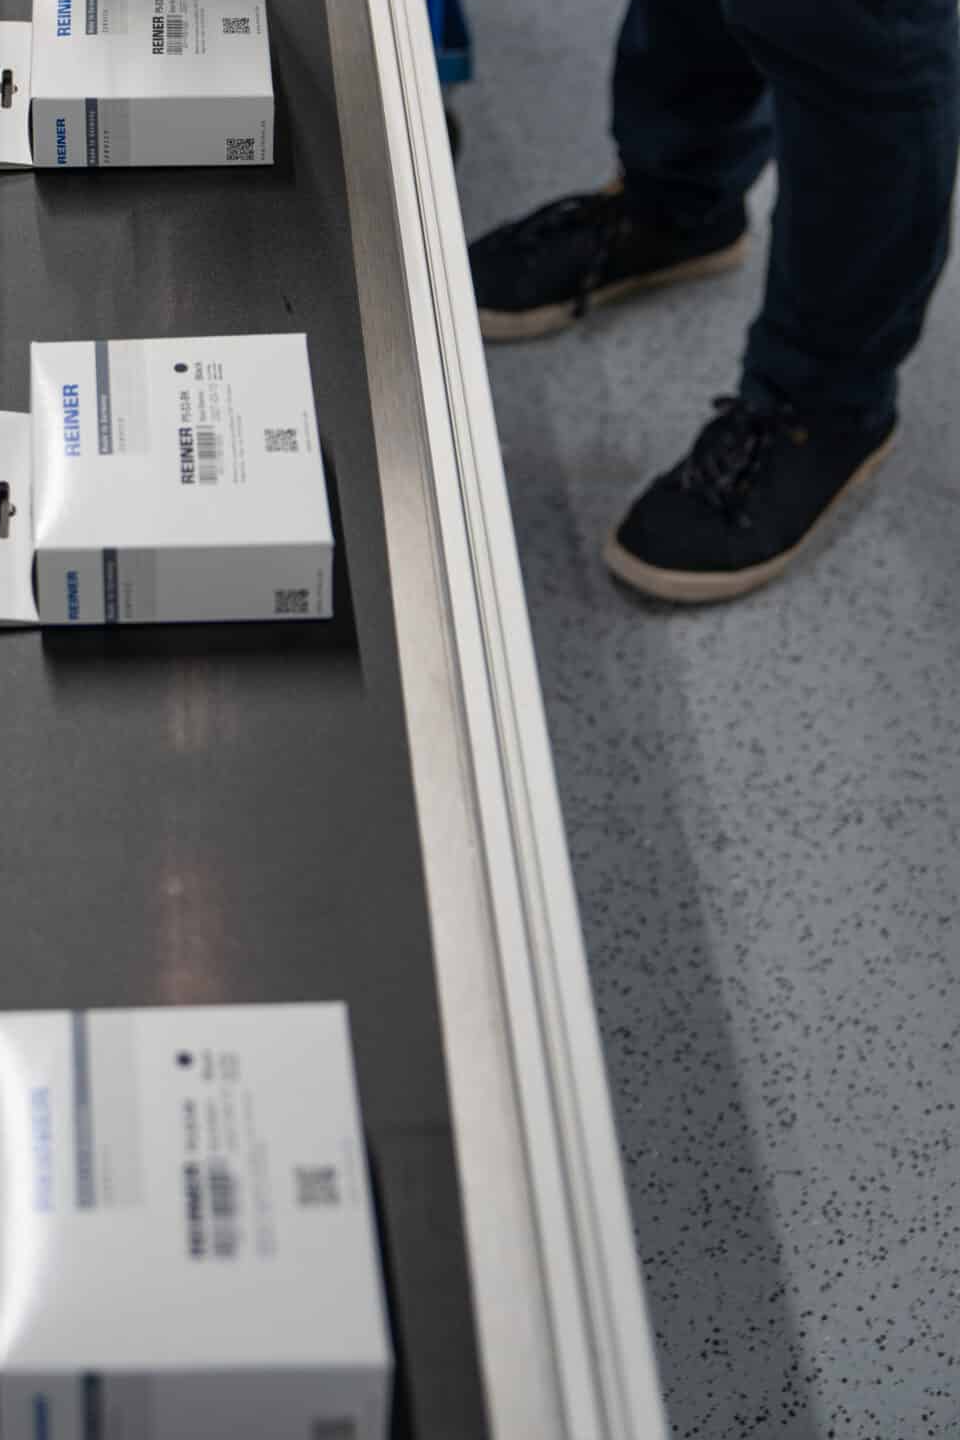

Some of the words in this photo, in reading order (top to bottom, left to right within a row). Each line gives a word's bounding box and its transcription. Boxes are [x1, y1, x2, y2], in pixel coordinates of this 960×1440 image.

[151, 16, 165, 55] REINER
[56, 118, 67, 164] REINER
[63, 383, 81, 457] REINER
[179, 427, 196, 485] REINER
